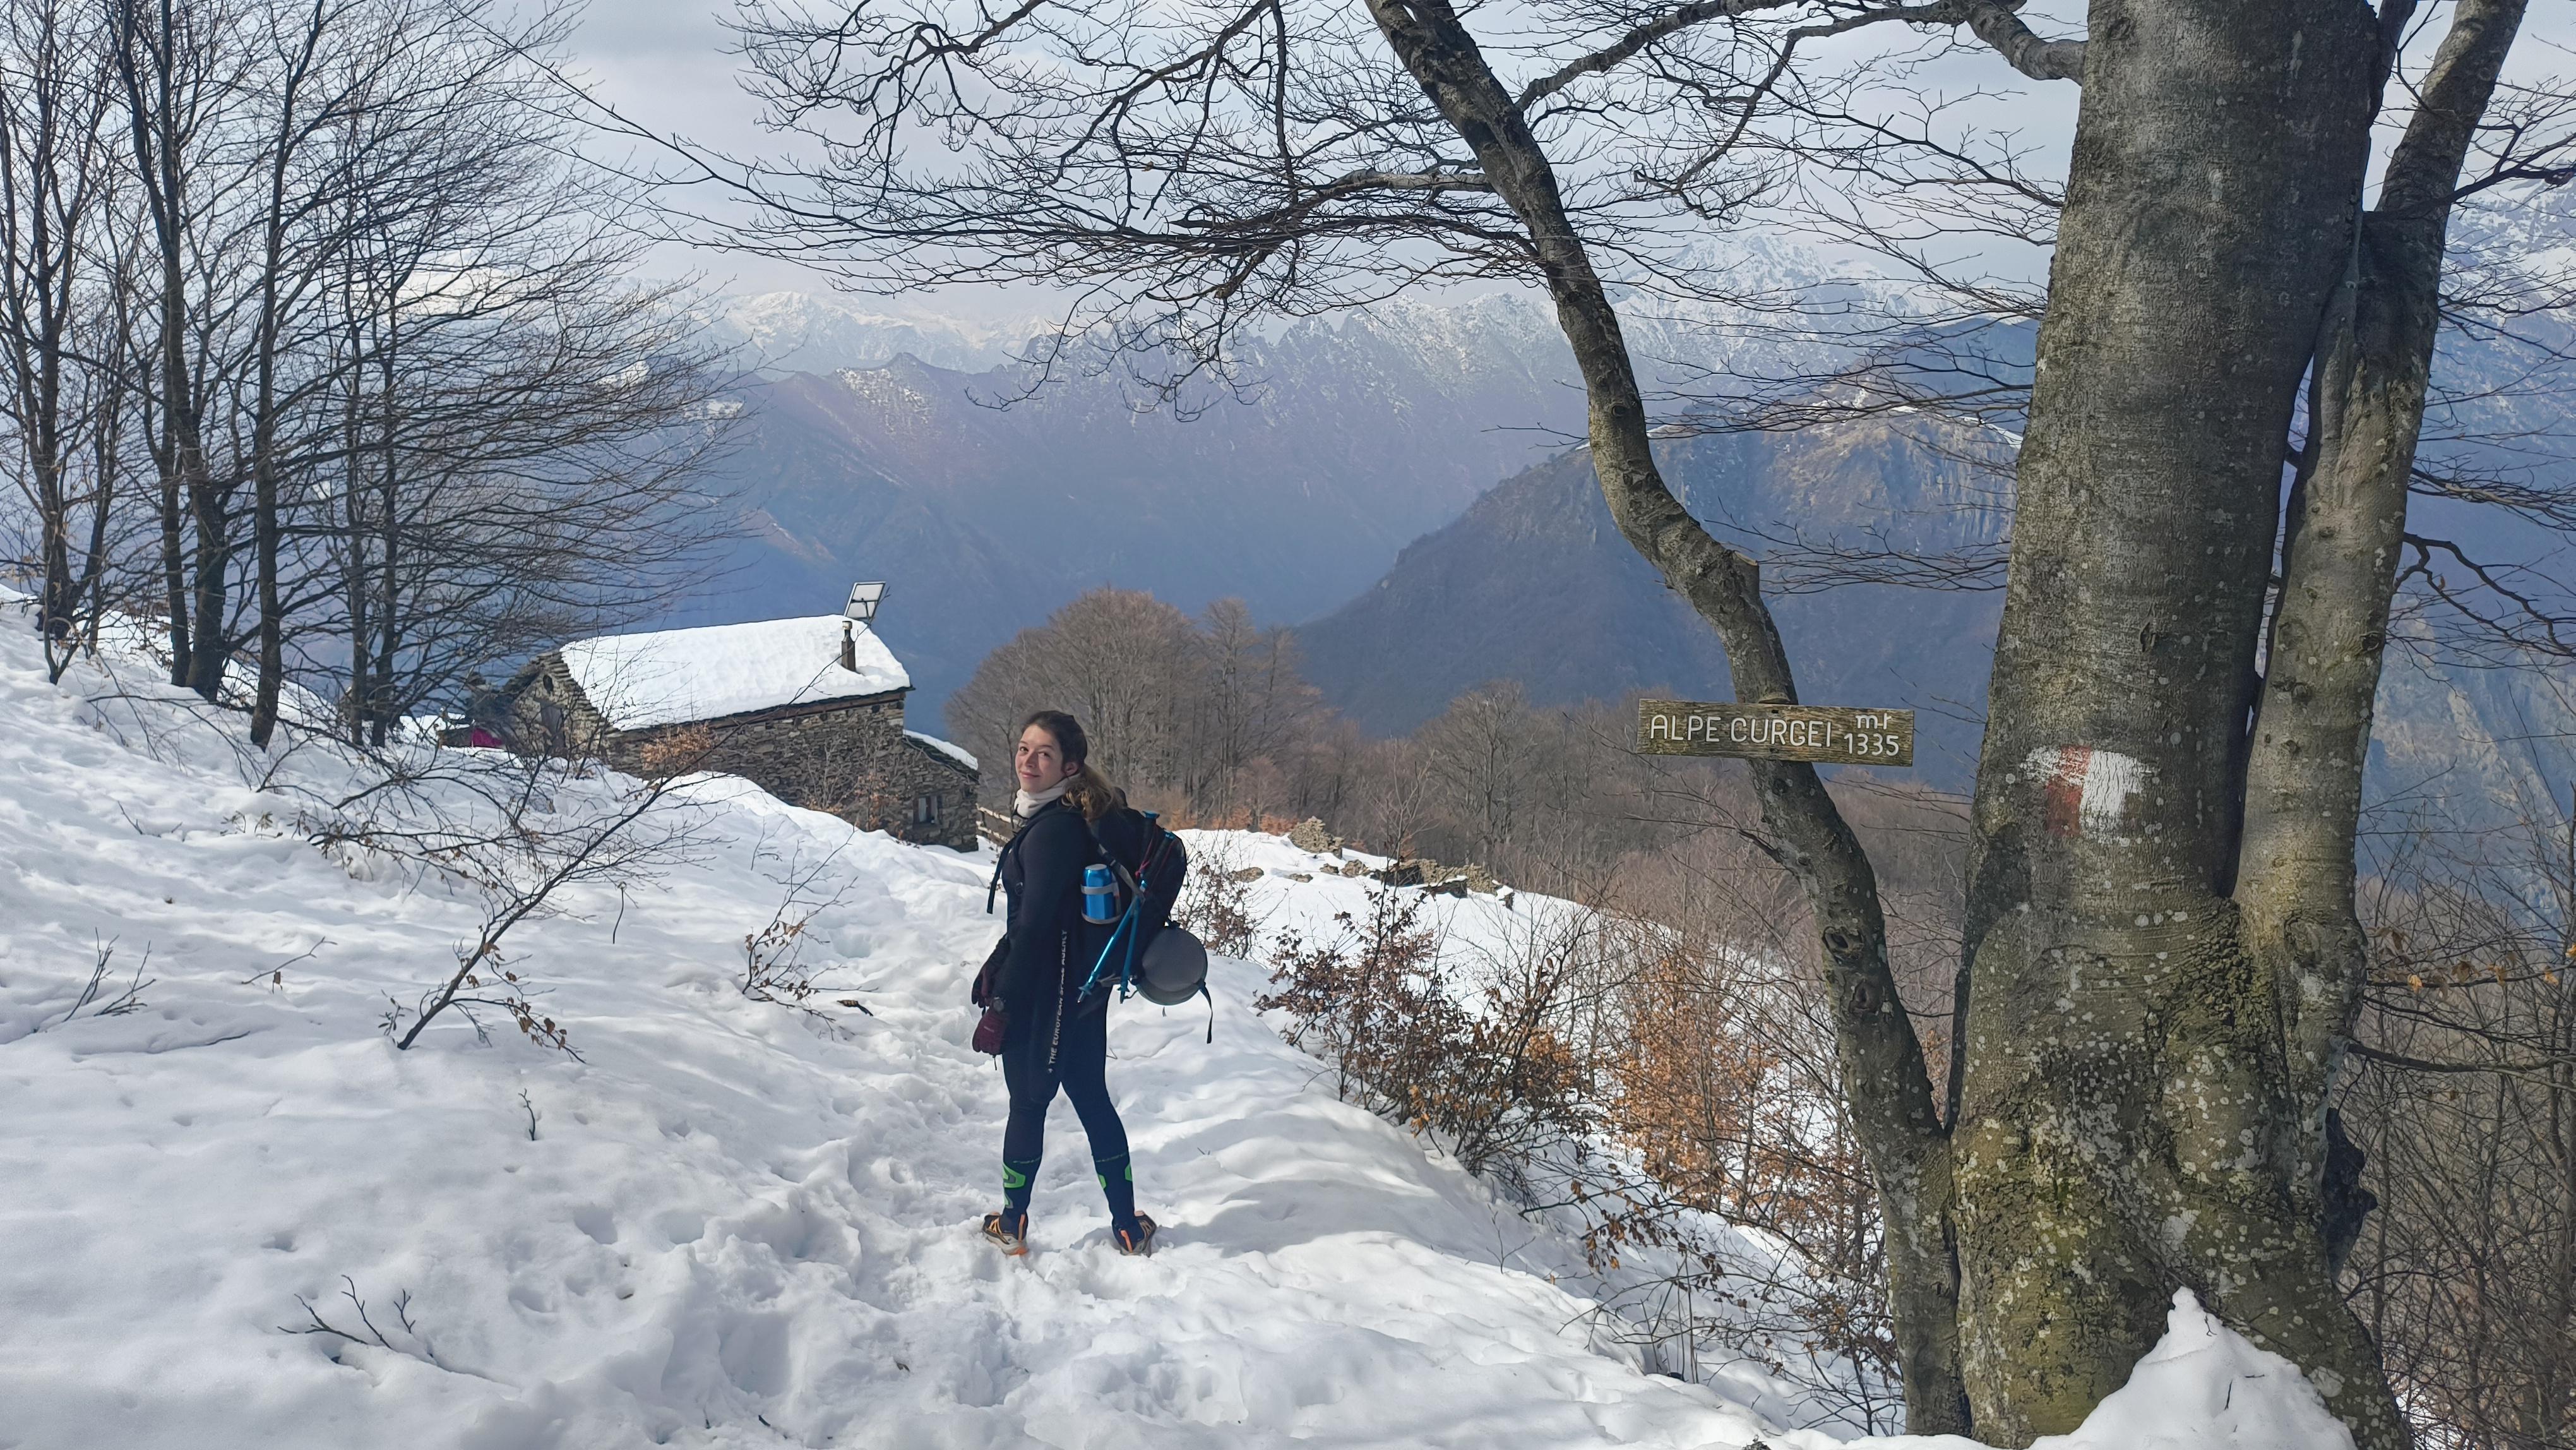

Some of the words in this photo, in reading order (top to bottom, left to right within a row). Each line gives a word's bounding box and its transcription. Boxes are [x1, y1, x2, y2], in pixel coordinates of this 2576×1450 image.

[1650, 714, 1721, 742] ALPE
[1731, 717, 1831, 748] CURGEI
[1844, 733, 1899, 756] 1335
[1049, 1047, 1058, 1065] THE
